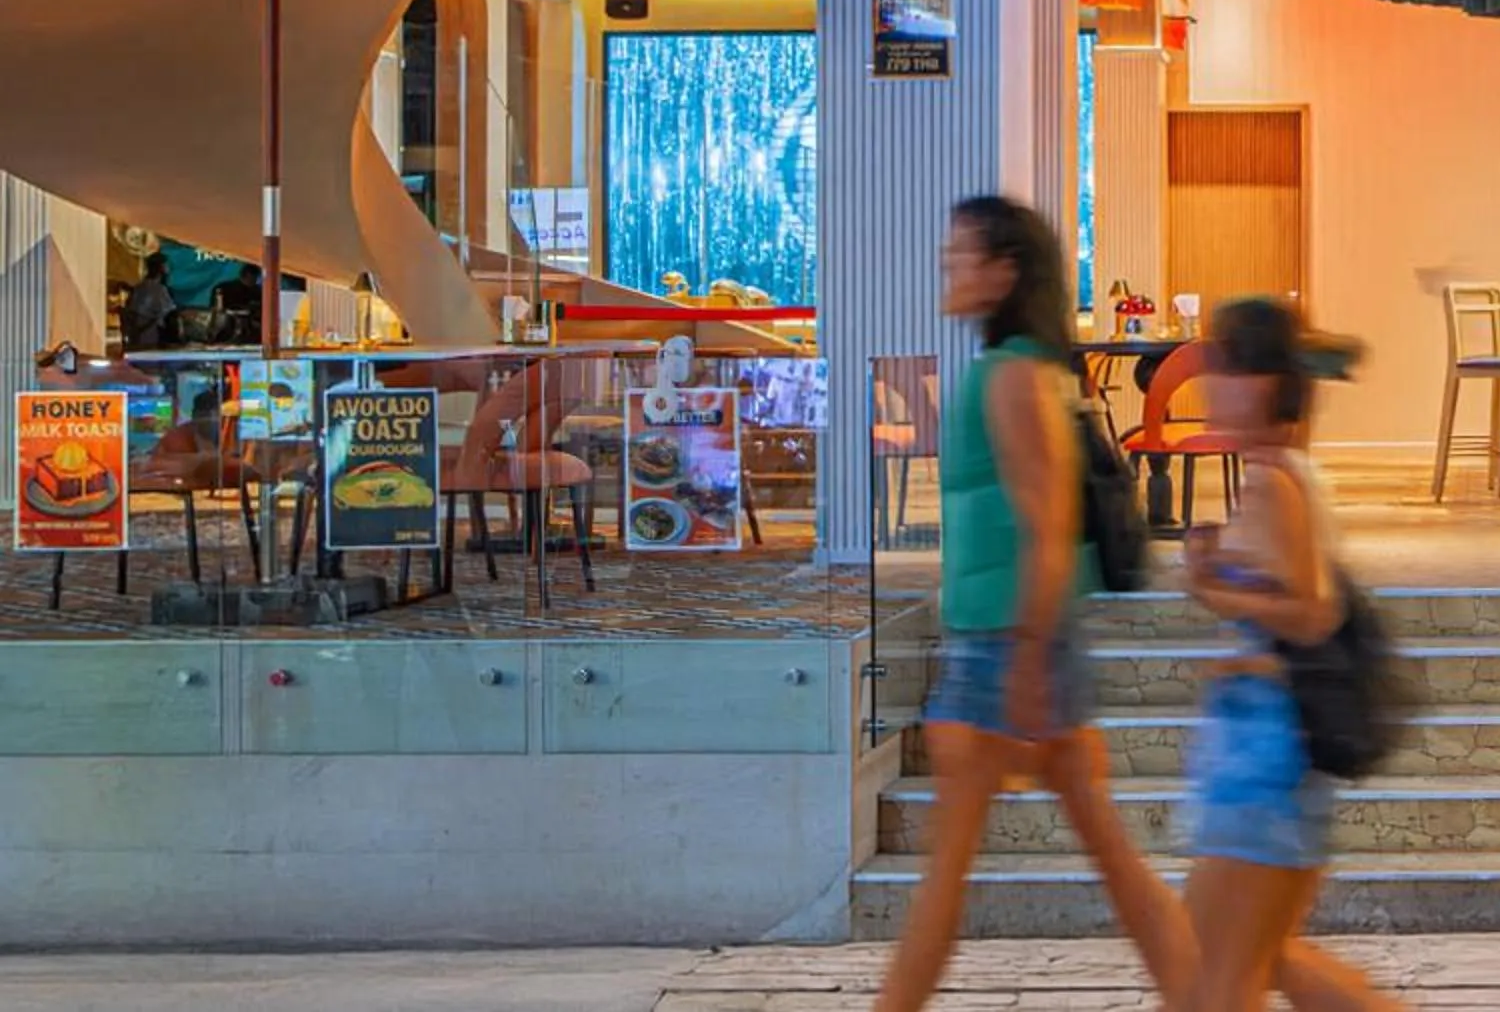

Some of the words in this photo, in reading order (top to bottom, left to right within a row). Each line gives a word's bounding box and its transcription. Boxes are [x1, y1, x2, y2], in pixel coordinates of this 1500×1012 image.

[32, 400, 111, 418] HONEY
[333, 397, 431, 418] AVOCADO
[21, 423, 61, 437] MILK
[66, 423, 121, 437] TOAST
[343, 419, 422, 440] TOAST
[343, 443, 425, 457] OURDOUGH
